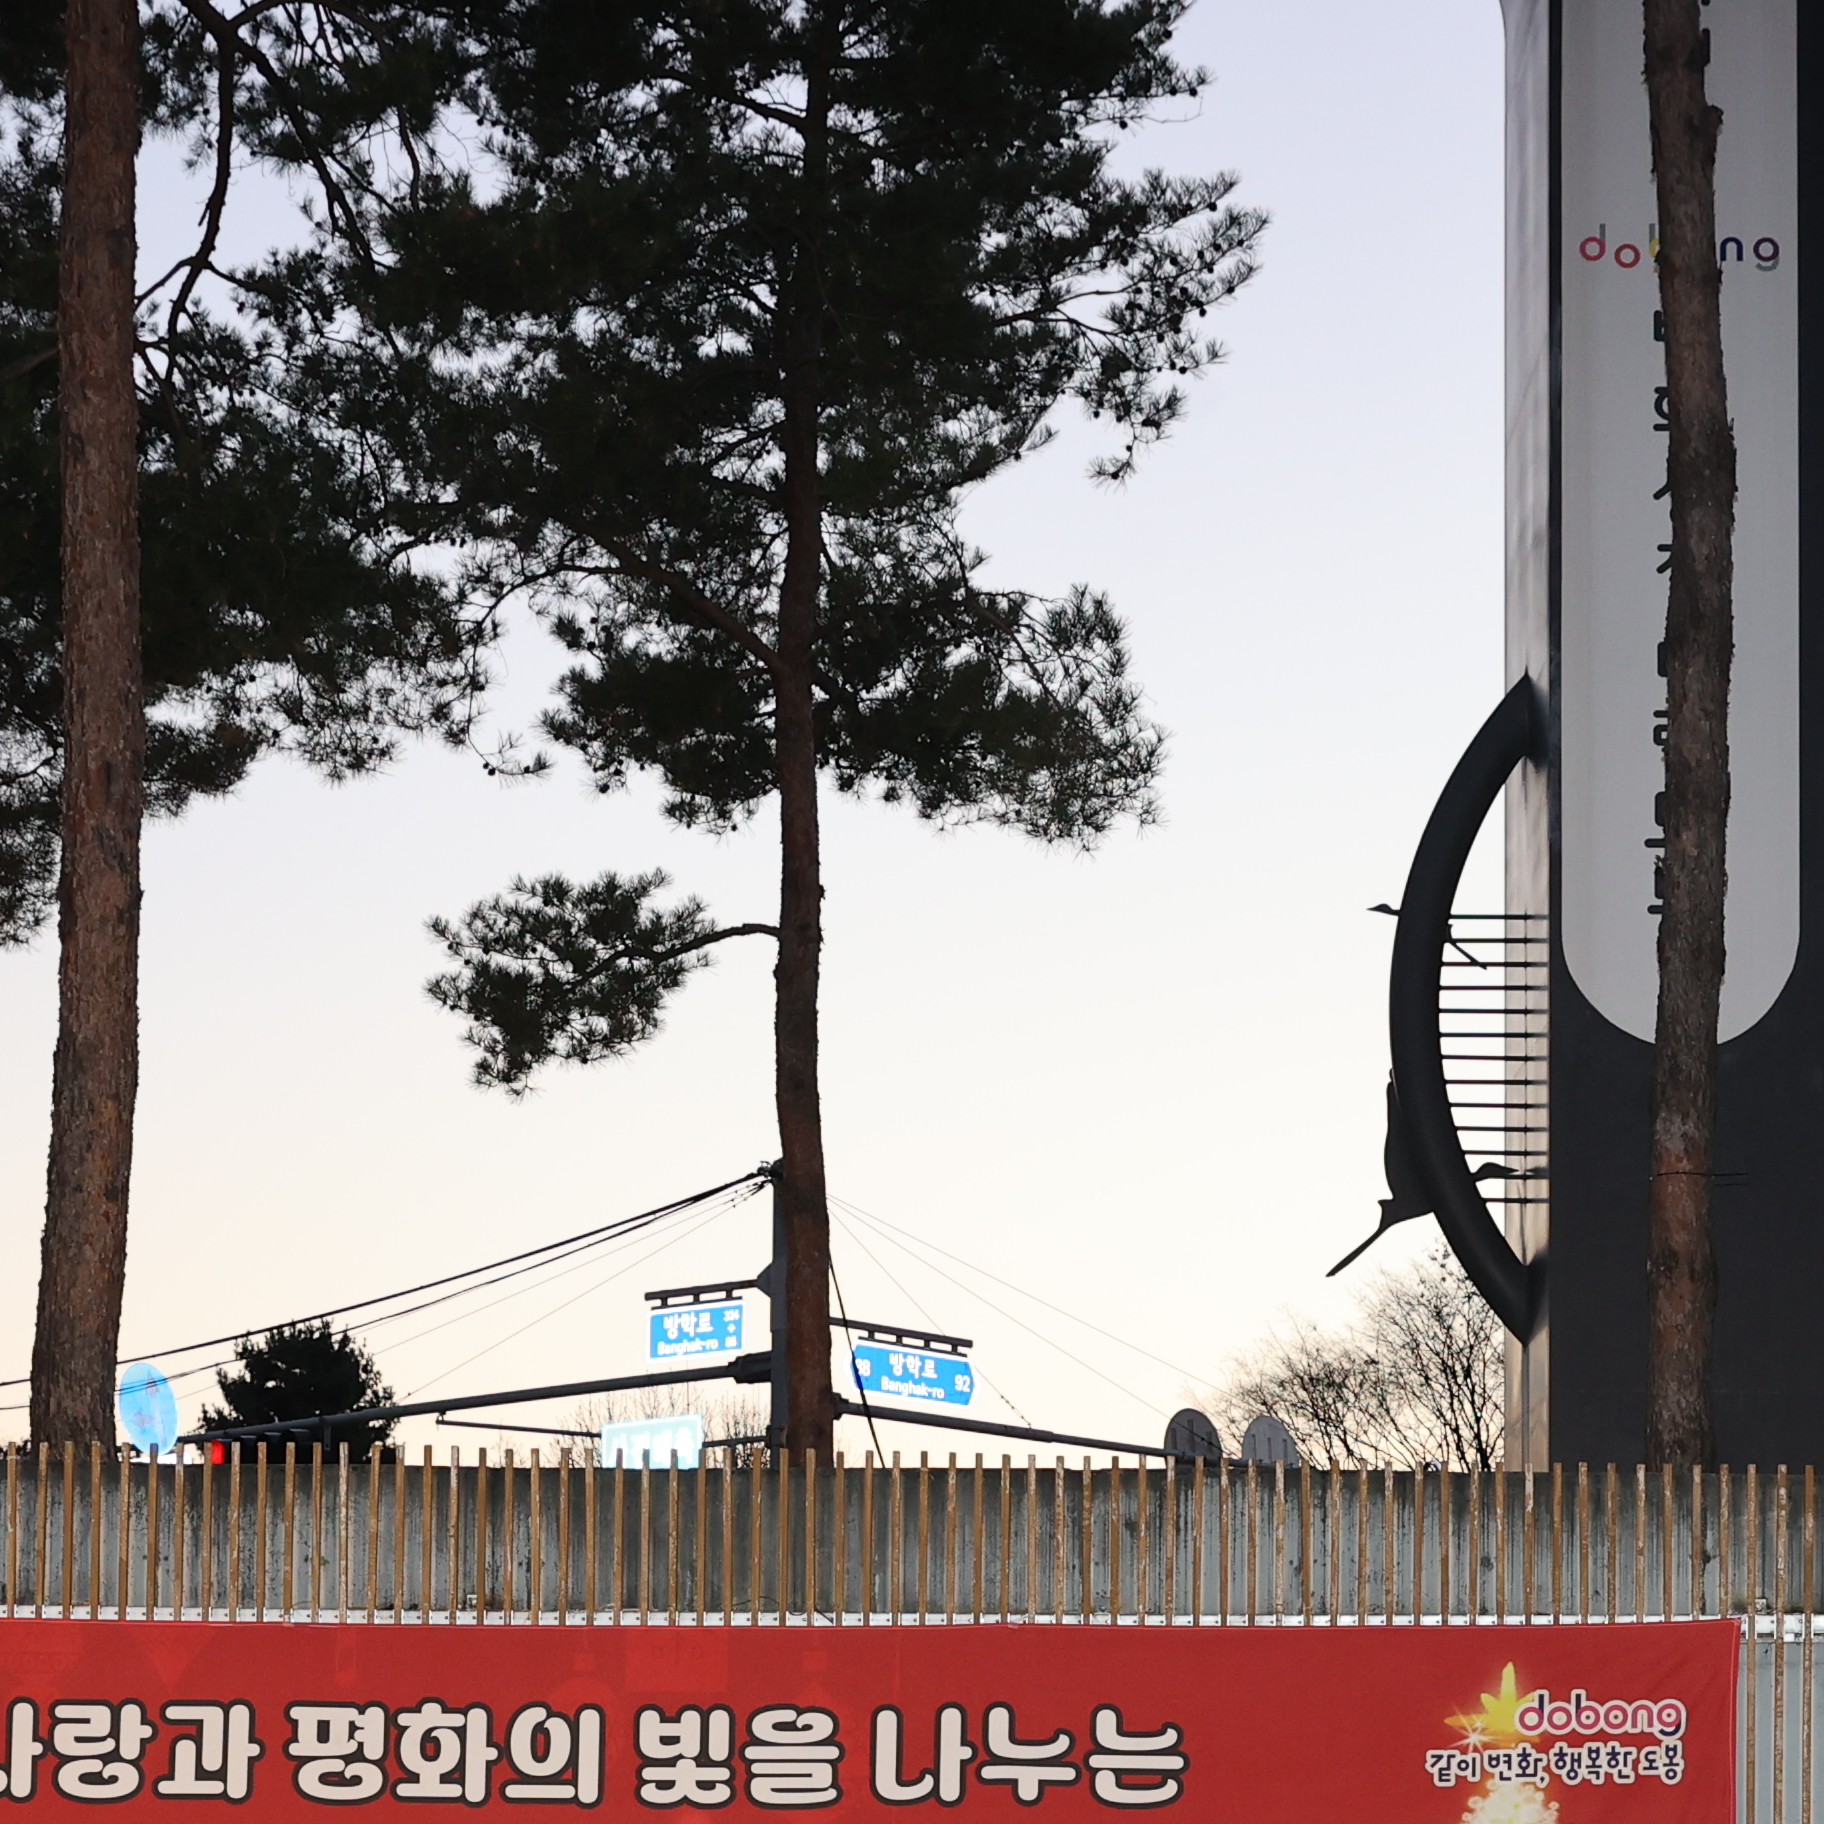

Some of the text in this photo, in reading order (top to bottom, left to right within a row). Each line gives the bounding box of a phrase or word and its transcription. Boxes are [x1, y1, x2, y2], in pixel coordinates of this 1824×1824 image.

[663, 1311, 714, 1339] 방학로
[657, 1338, 719, 1356] Banghak-ro
[889, 1353, 938, 1379] 방학로
[881, 1376, 945, 1399] Banghak-ro
[954, 1374, 971, 1393] 92
[1515, 1689, 1686, 1739] dobong
[286, 1698, 605, 1805] 평화의
[636, 1703, 845, 1805] 빛을
[871, 1703, 1188, 1806] 나누는
[1428, 1743, 1681, 1785] 같이 변화, 행복한 도봉
